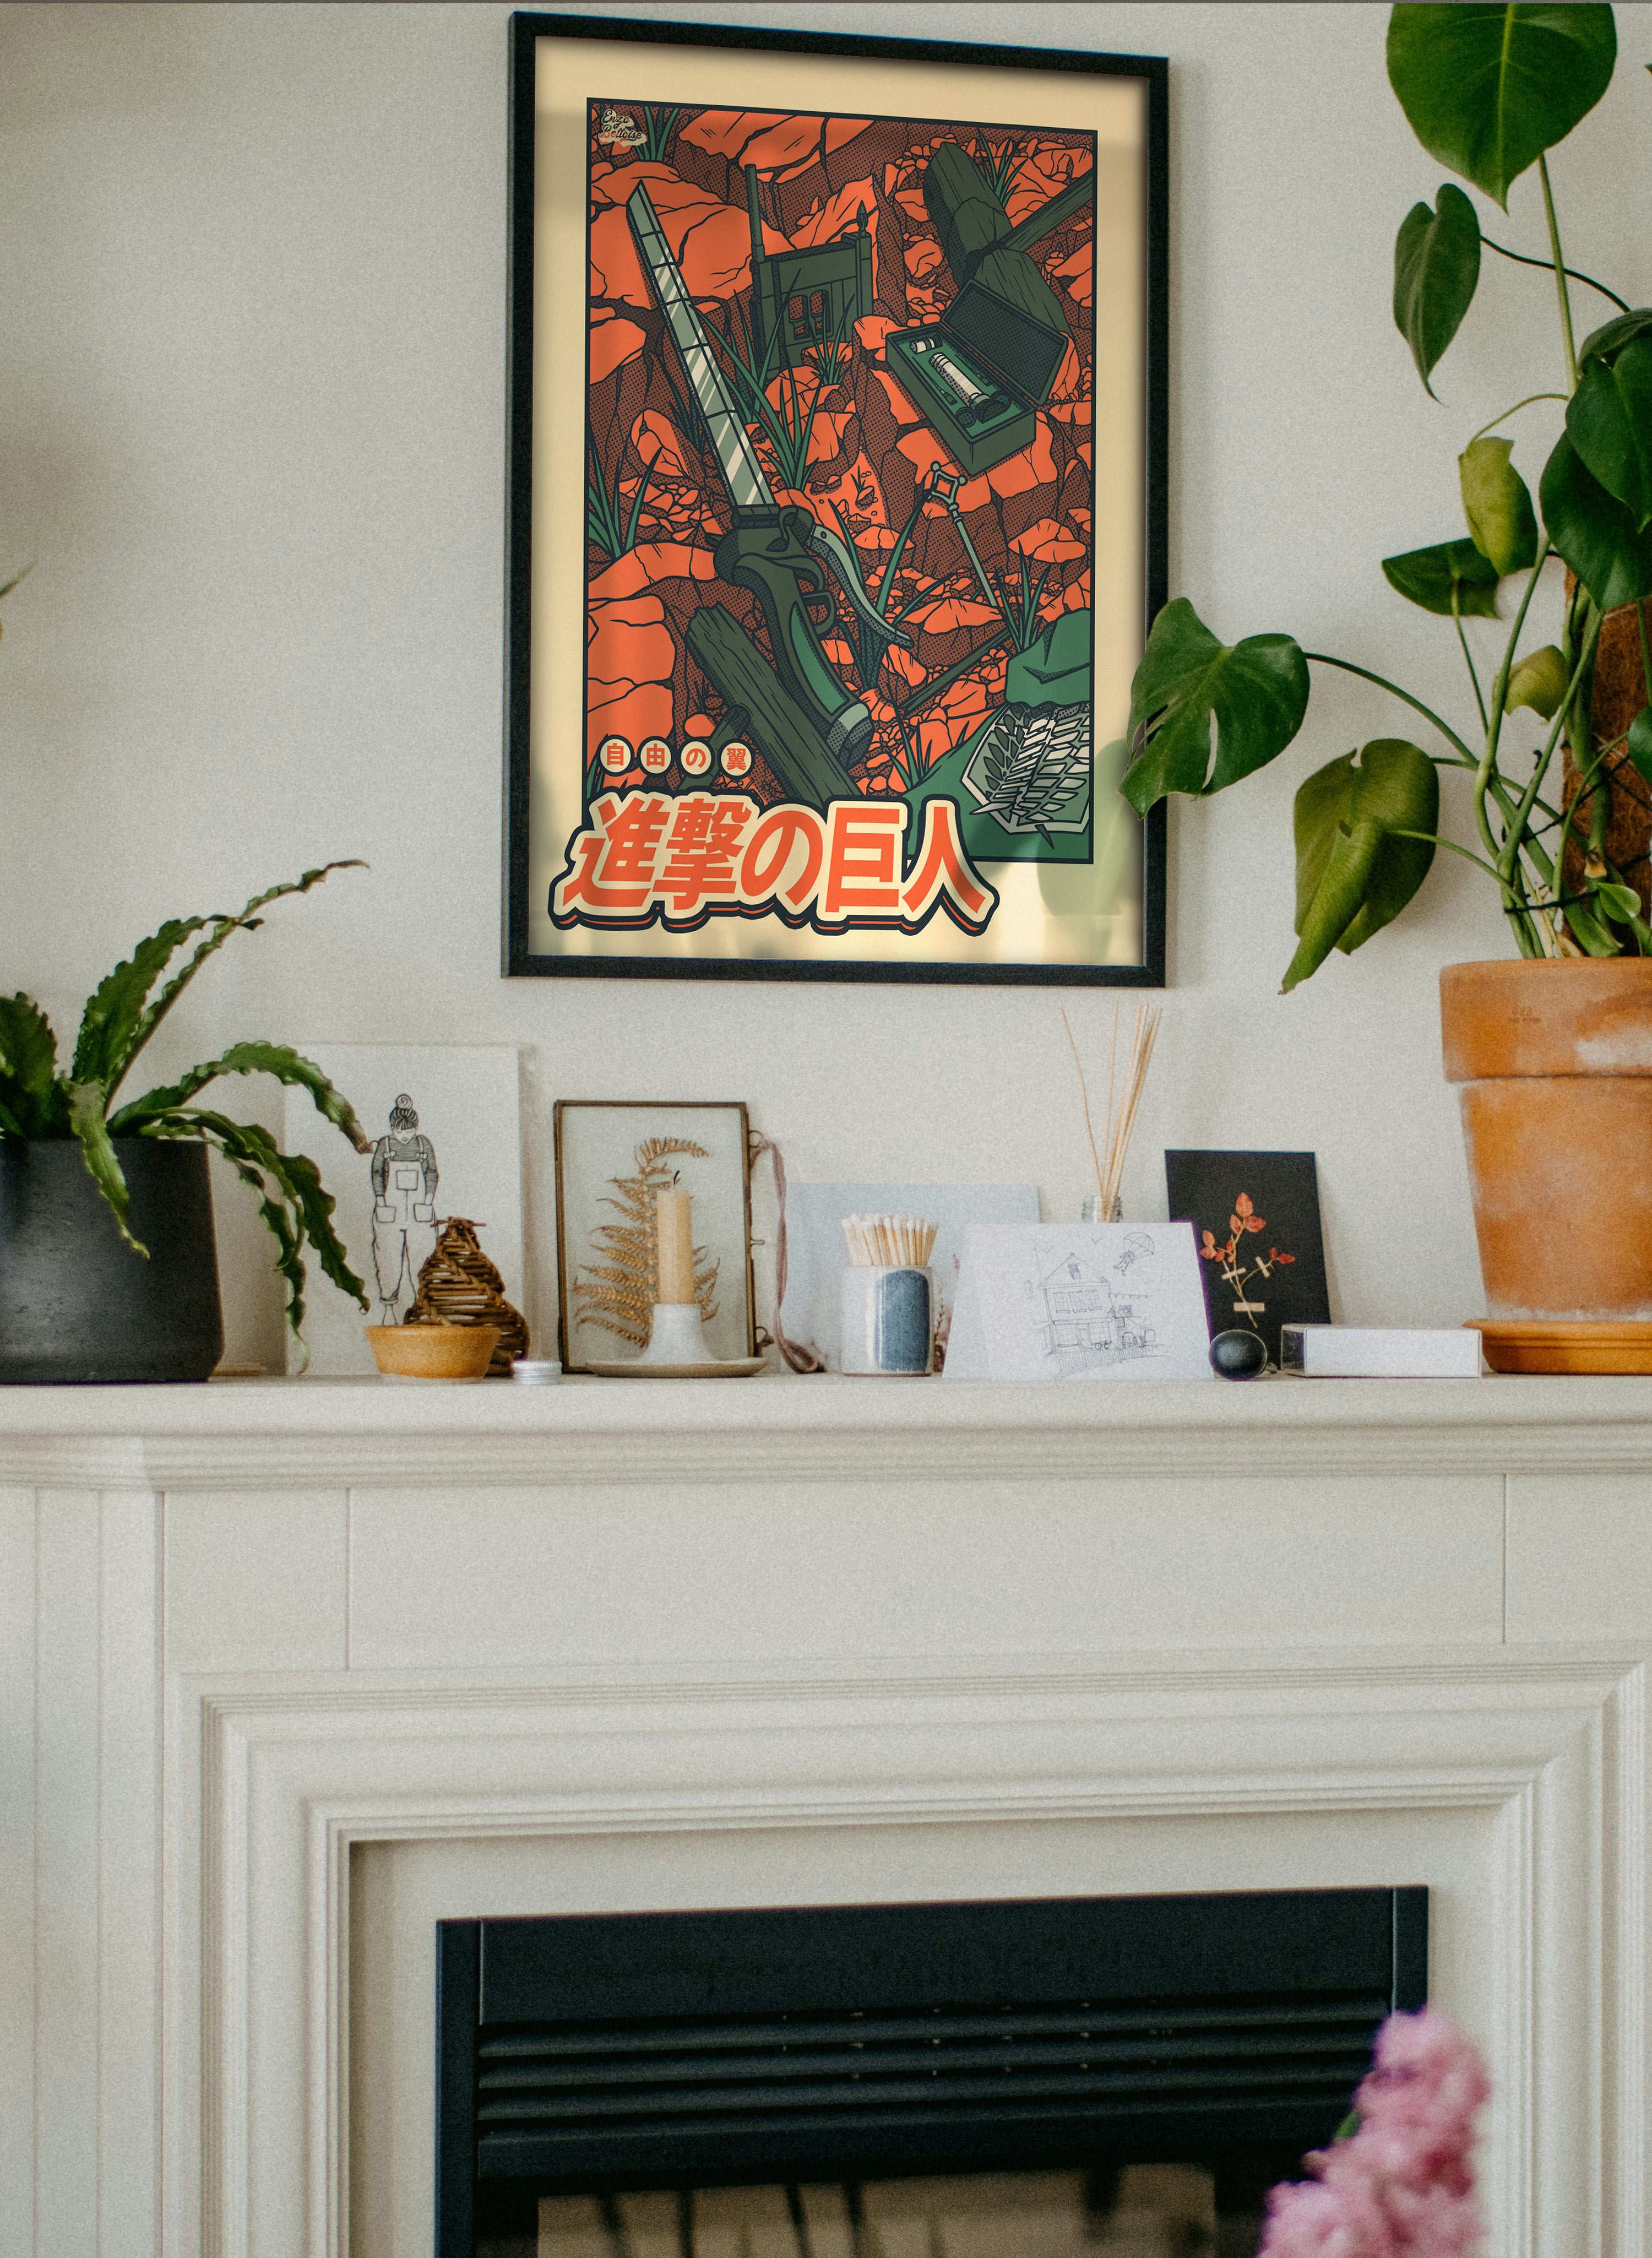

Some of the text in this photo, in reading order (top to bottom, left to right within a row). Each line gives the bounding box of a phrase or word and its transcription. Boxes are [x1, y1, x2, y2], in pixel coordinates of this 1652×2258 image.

[602, 109, 630, 129] Enzo
[606, 742, 747, 772] 自由の翼
[563, 796, 986, 915] 進撃の巨人
